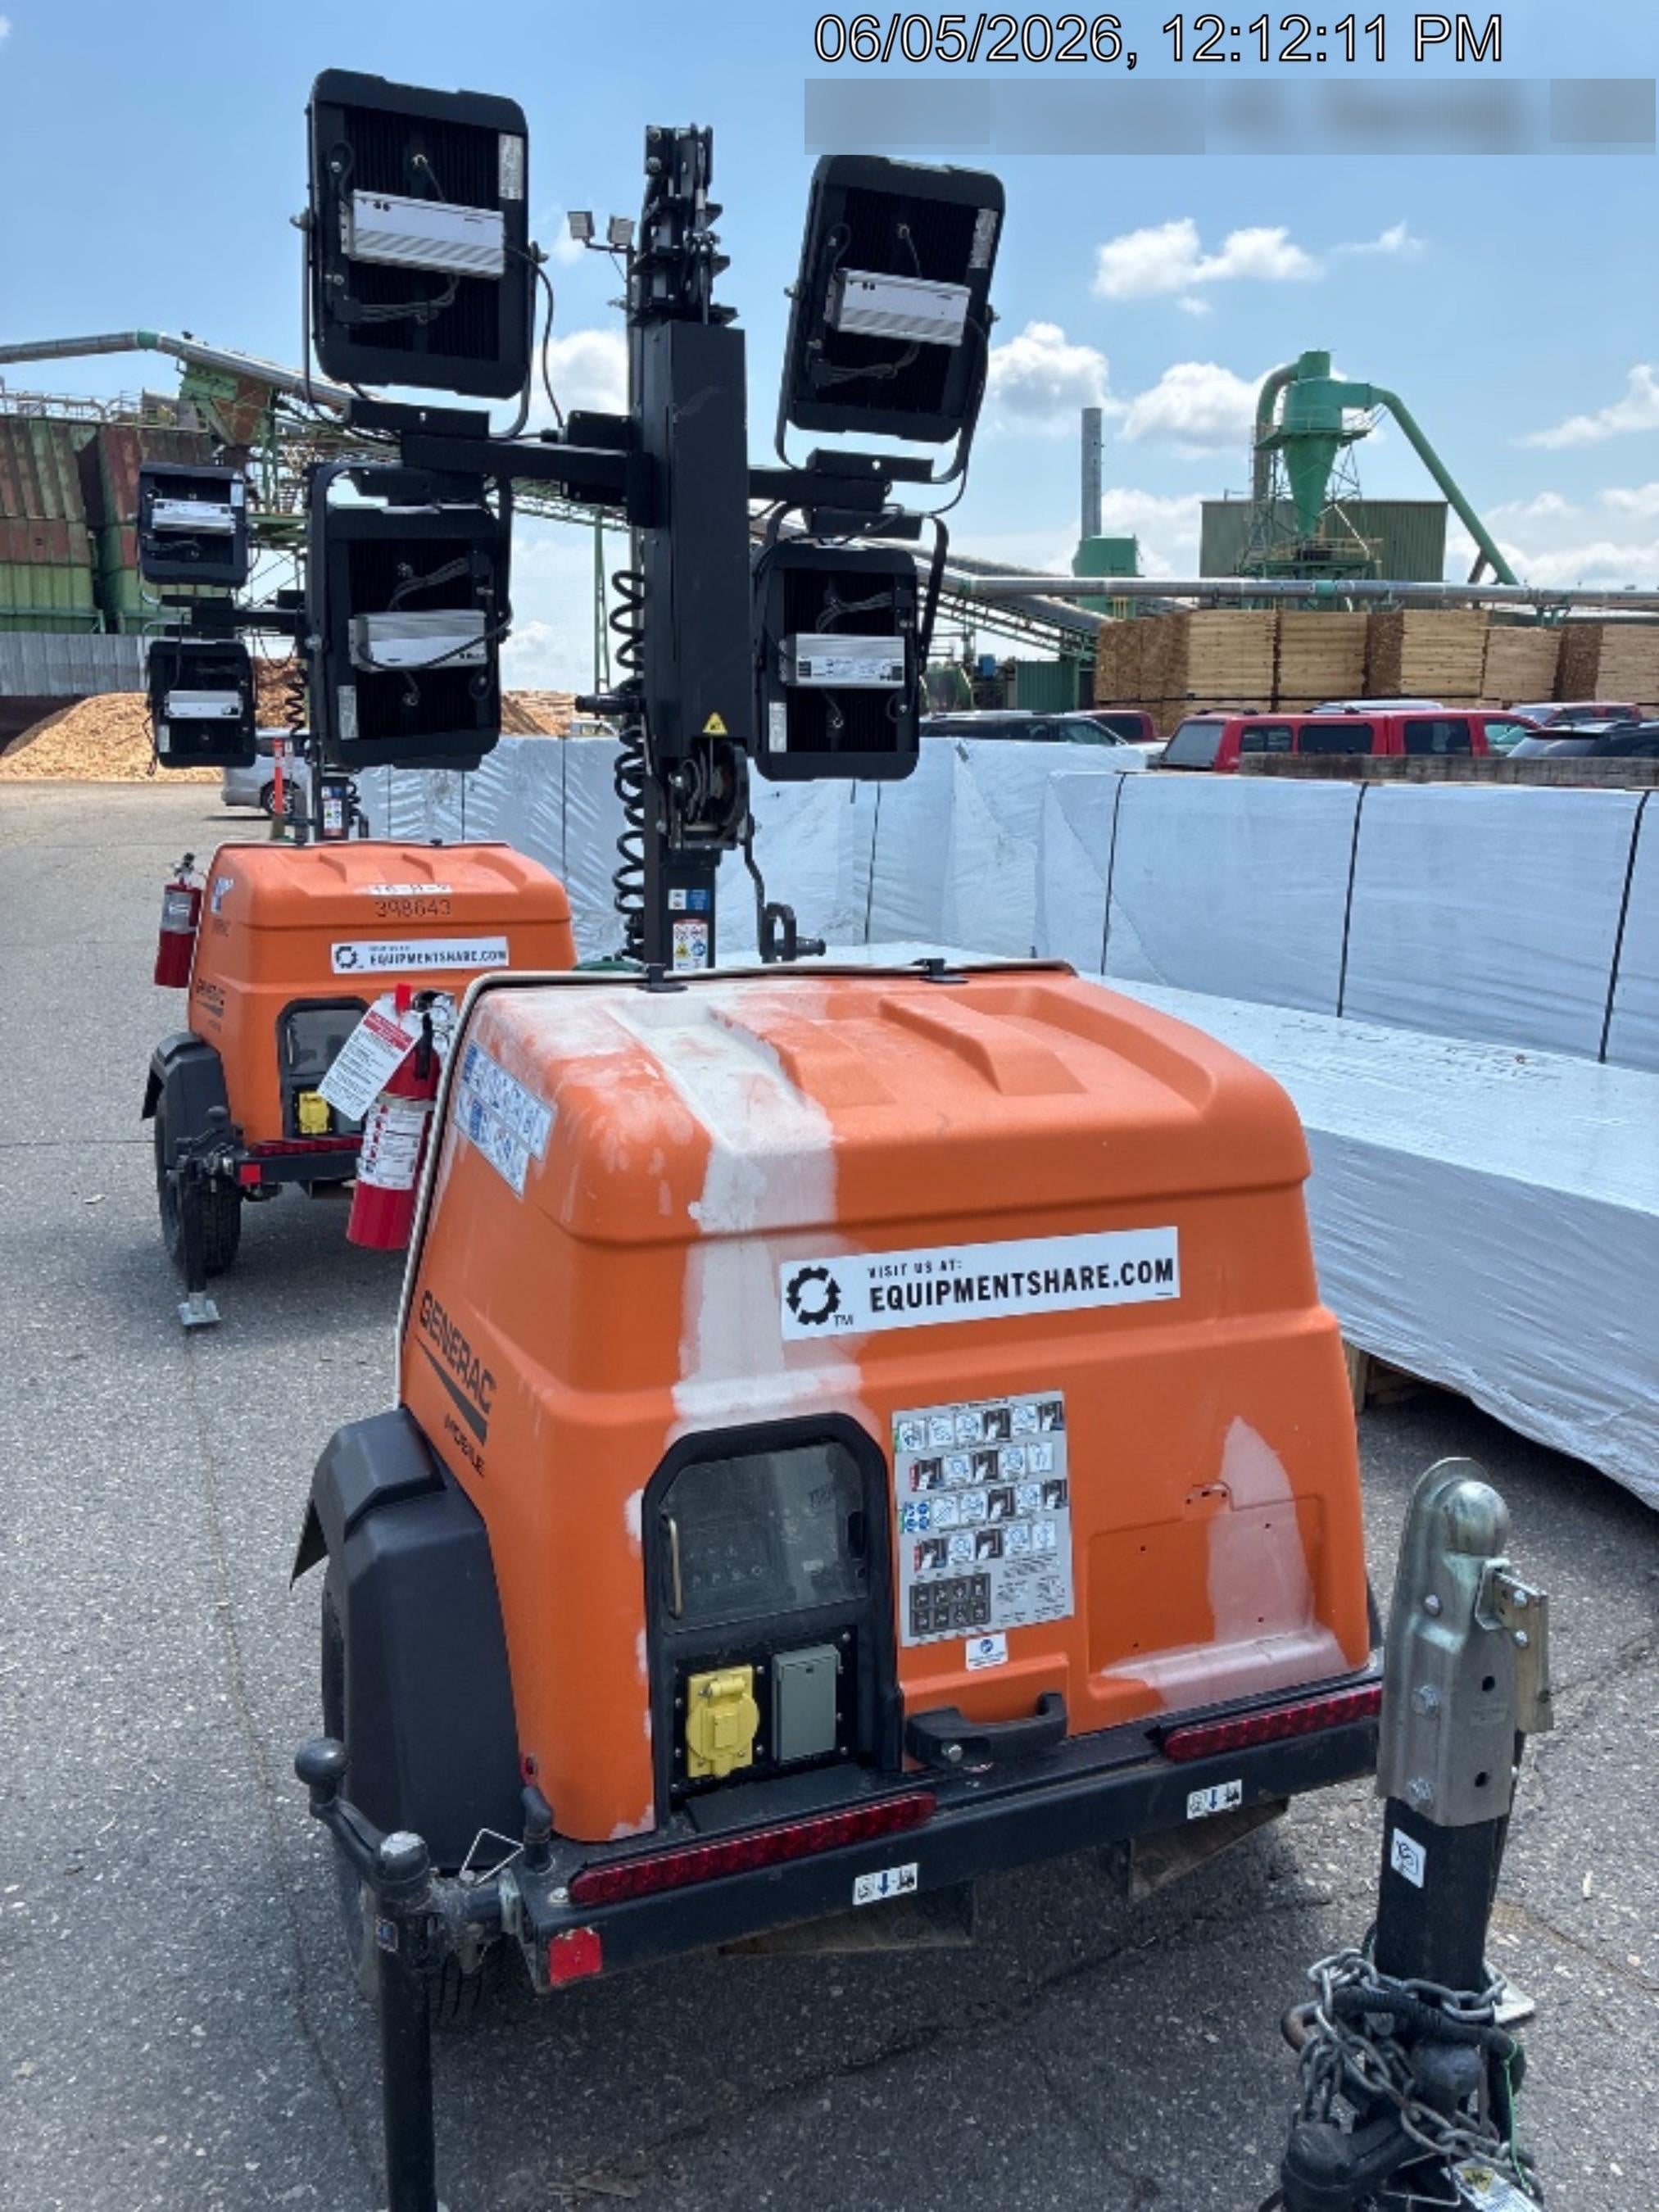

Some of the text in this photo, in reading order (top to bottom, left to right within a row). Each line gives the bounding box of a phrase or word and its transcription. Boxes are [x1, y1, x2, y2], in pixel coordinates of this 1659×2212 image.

[868, 1258, 963, 1279] VISIT US AT:
[868, 1258, 1174, 1313] EQUIPMENTSHARE.COM
[419, 1289, 496, 1415] GENERAC
